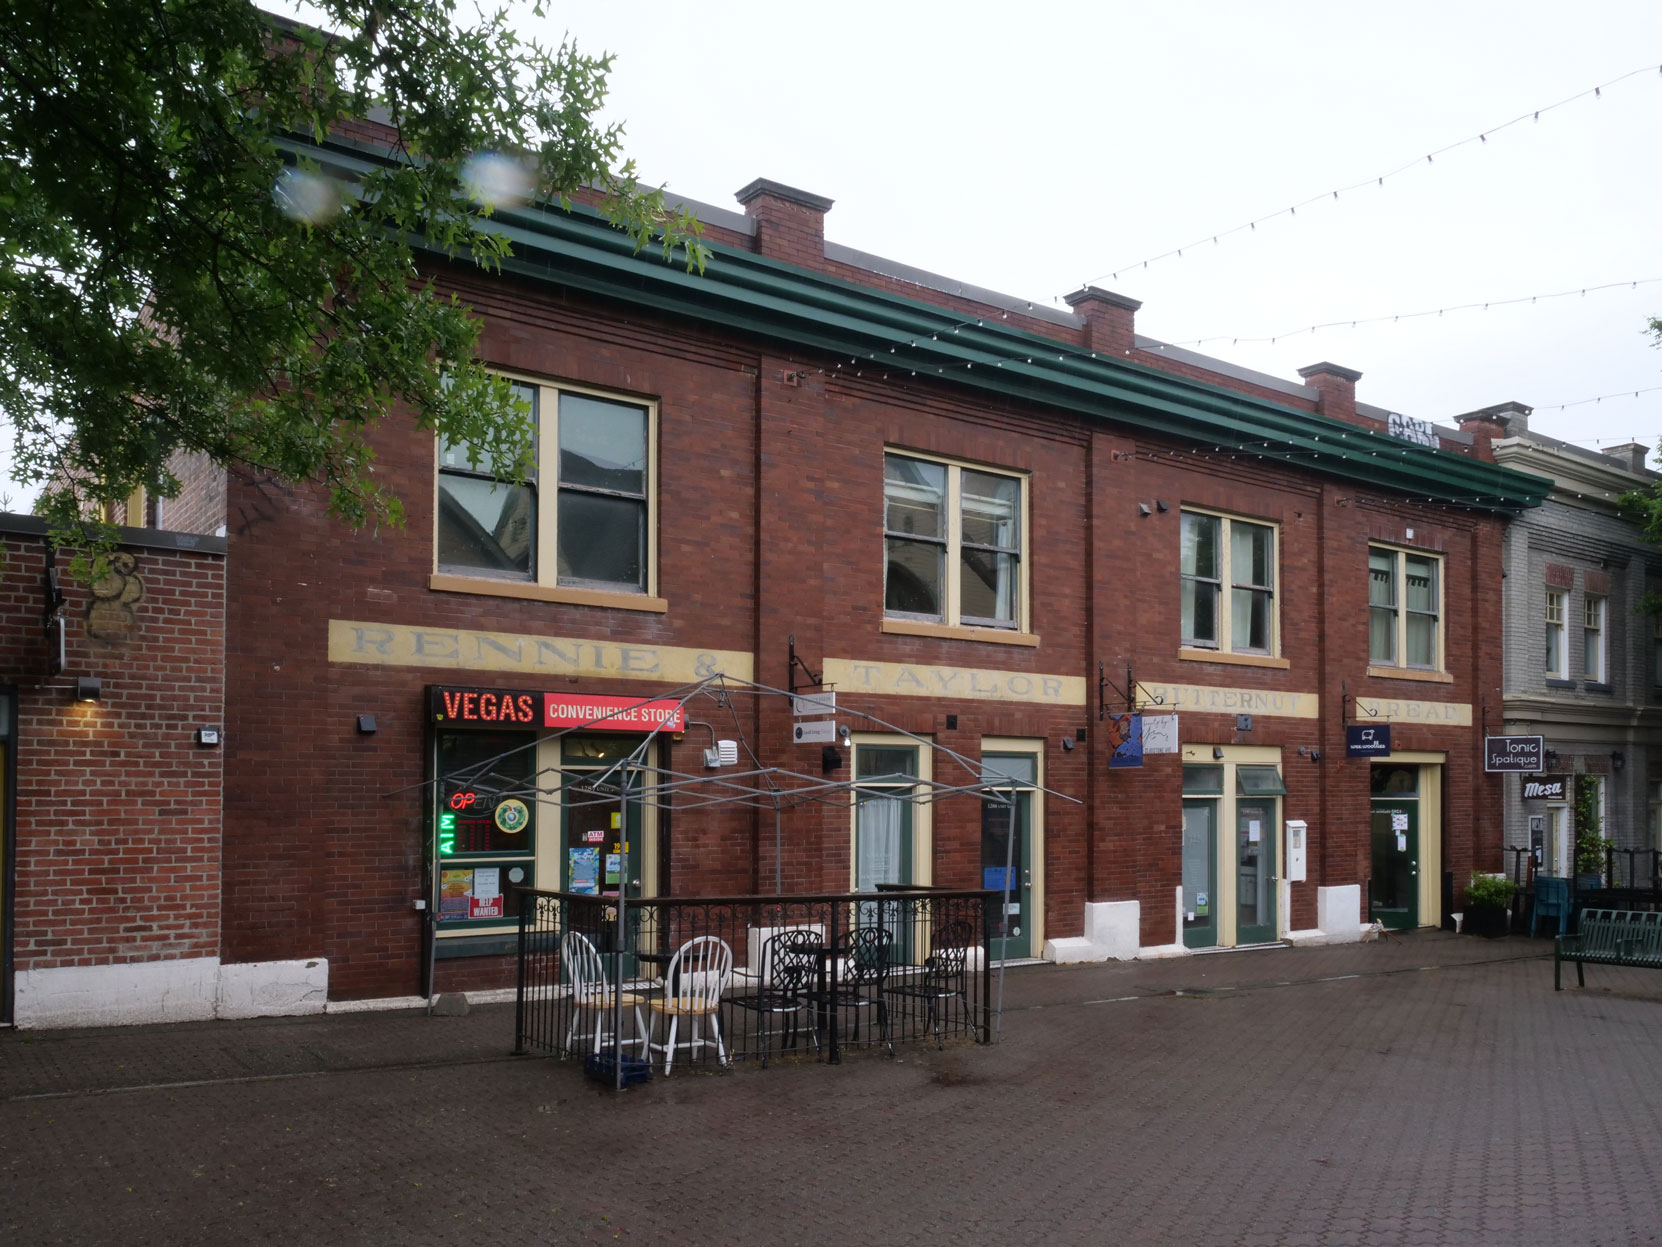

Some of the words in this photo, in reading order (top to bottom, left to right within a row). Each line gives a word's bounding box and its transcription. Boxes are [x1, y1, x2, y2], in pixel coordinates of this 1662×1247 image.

[350, 626, 660, 673] RENNIE
[694, 653, 725, 679] &
[853, 664, 1063, 698] TAYLOR
[443, 691, 534, 723] VEGAS
[550, 703, 638, 721] CONVENIENCE
[641, 707, 681, 723] STORE
[1152, 686, 1300, 713] BUTTERNUT
[1367, 700, 1457, 720] BREAD
[1505, 739, 1538, 753] Tonic
[1490, 753, 1537, 767] Spatique
[1524, 782, 1562, 798] Mesa
[450, 792, 496, 810] OPEN
[473, 906, 499, 917] WANTED
